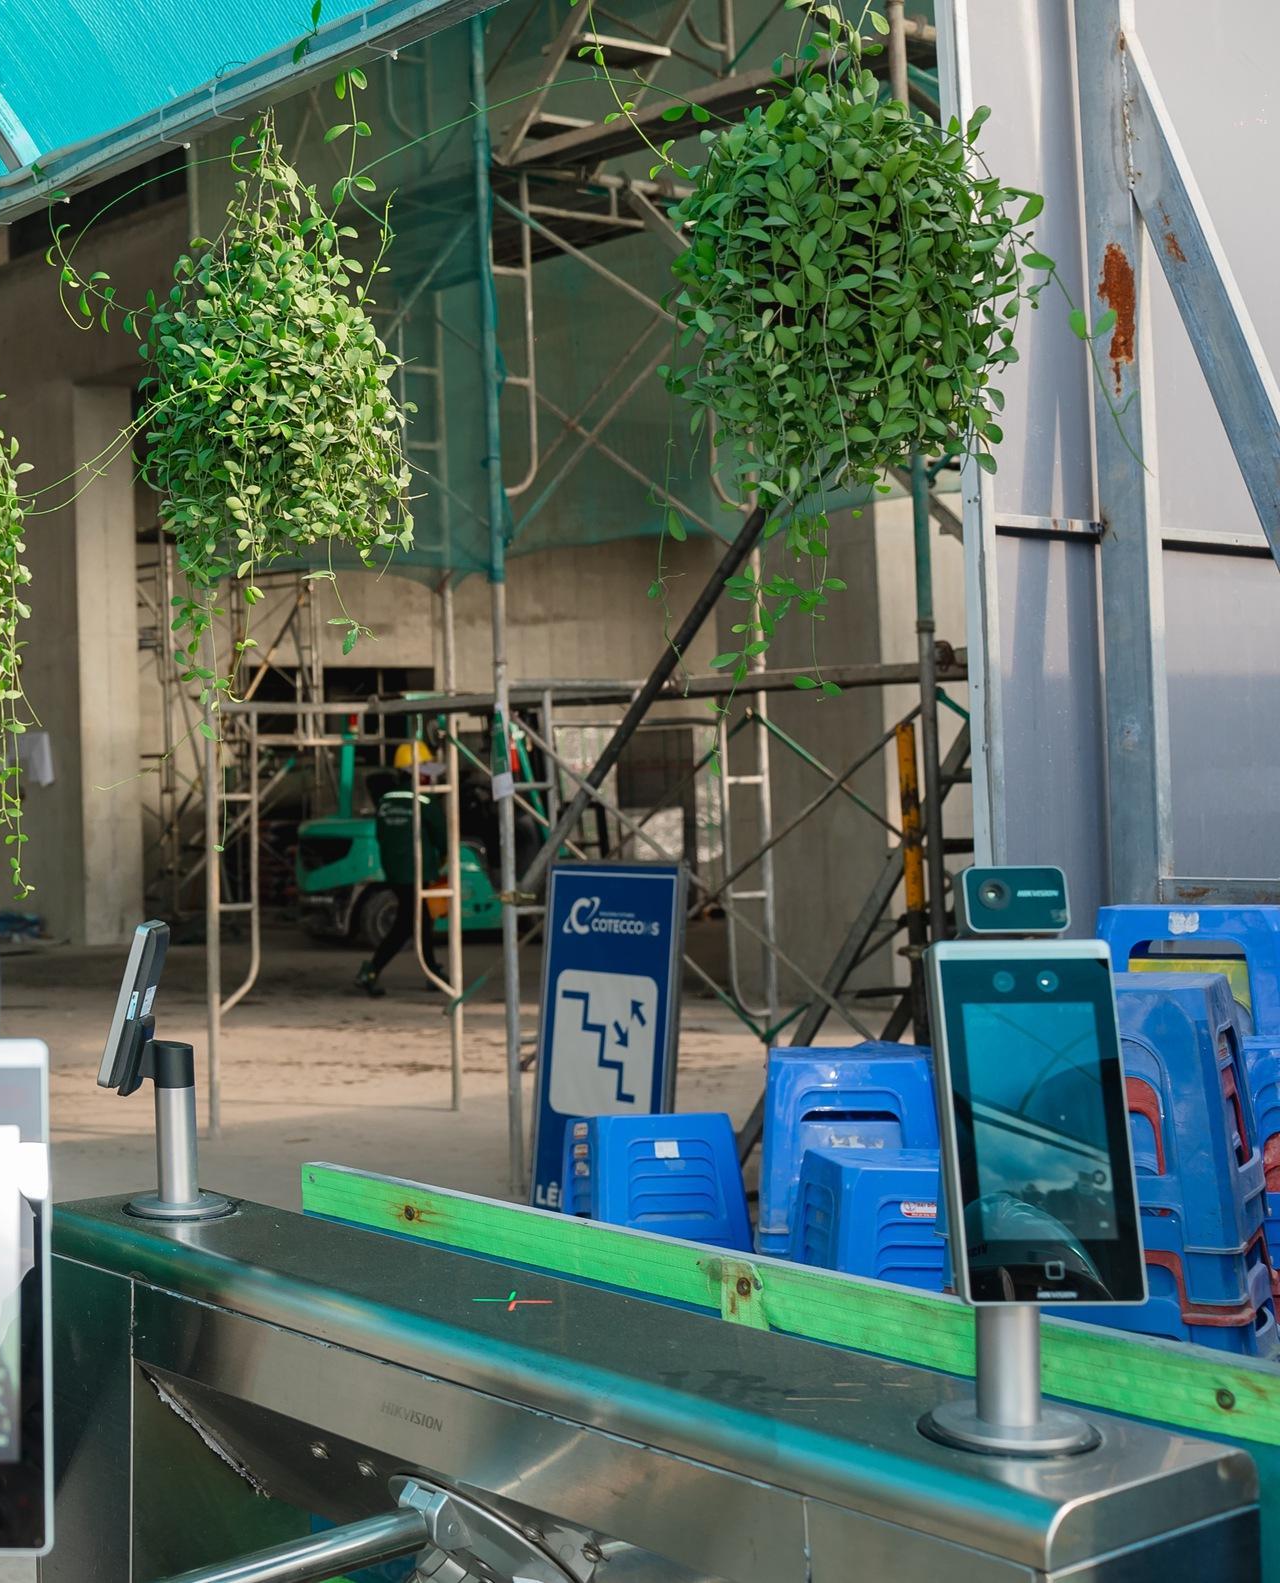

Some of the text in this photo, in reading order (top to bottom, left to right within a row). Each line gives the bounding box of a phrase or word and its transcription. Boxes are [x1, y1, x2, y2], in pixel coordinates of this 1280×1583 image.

[591, 917, 661, 937] COTECCOS
[535, 1181, 563, 1208] LÊ
[380, 1401, 444, 1432] HIKVISION
